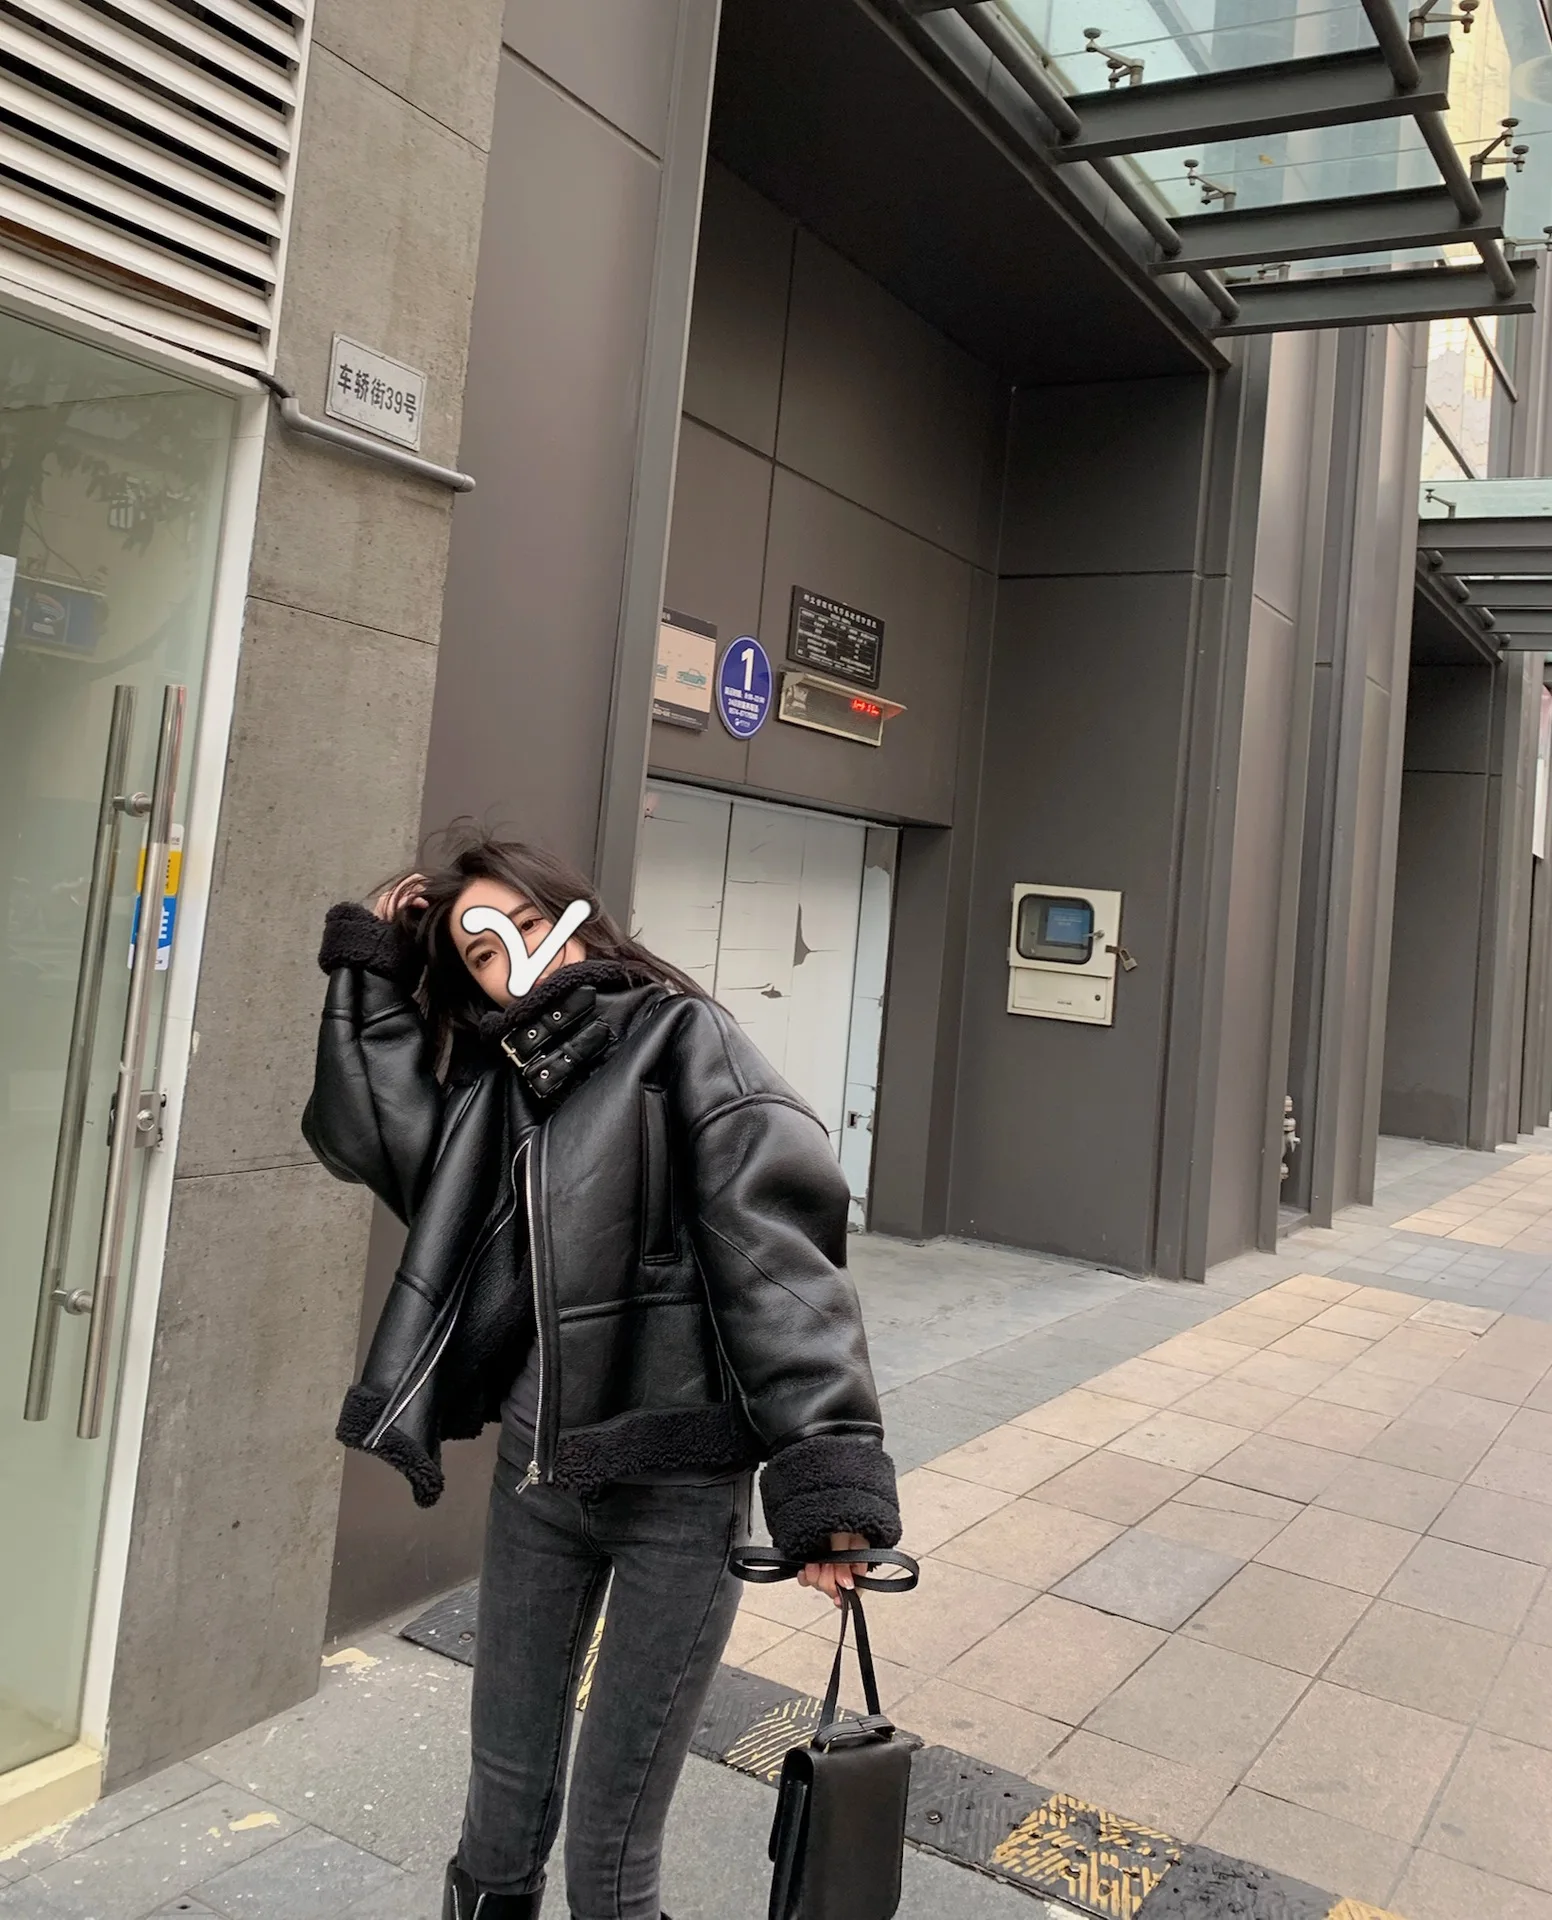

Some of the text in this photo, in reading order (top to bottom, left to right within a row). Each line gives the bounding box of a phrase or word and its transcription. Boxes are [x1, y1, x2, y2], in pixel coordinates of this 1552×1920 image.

[337, 363, 417, 423] 车轿街39号
[741, 647, 755, 691] 1
